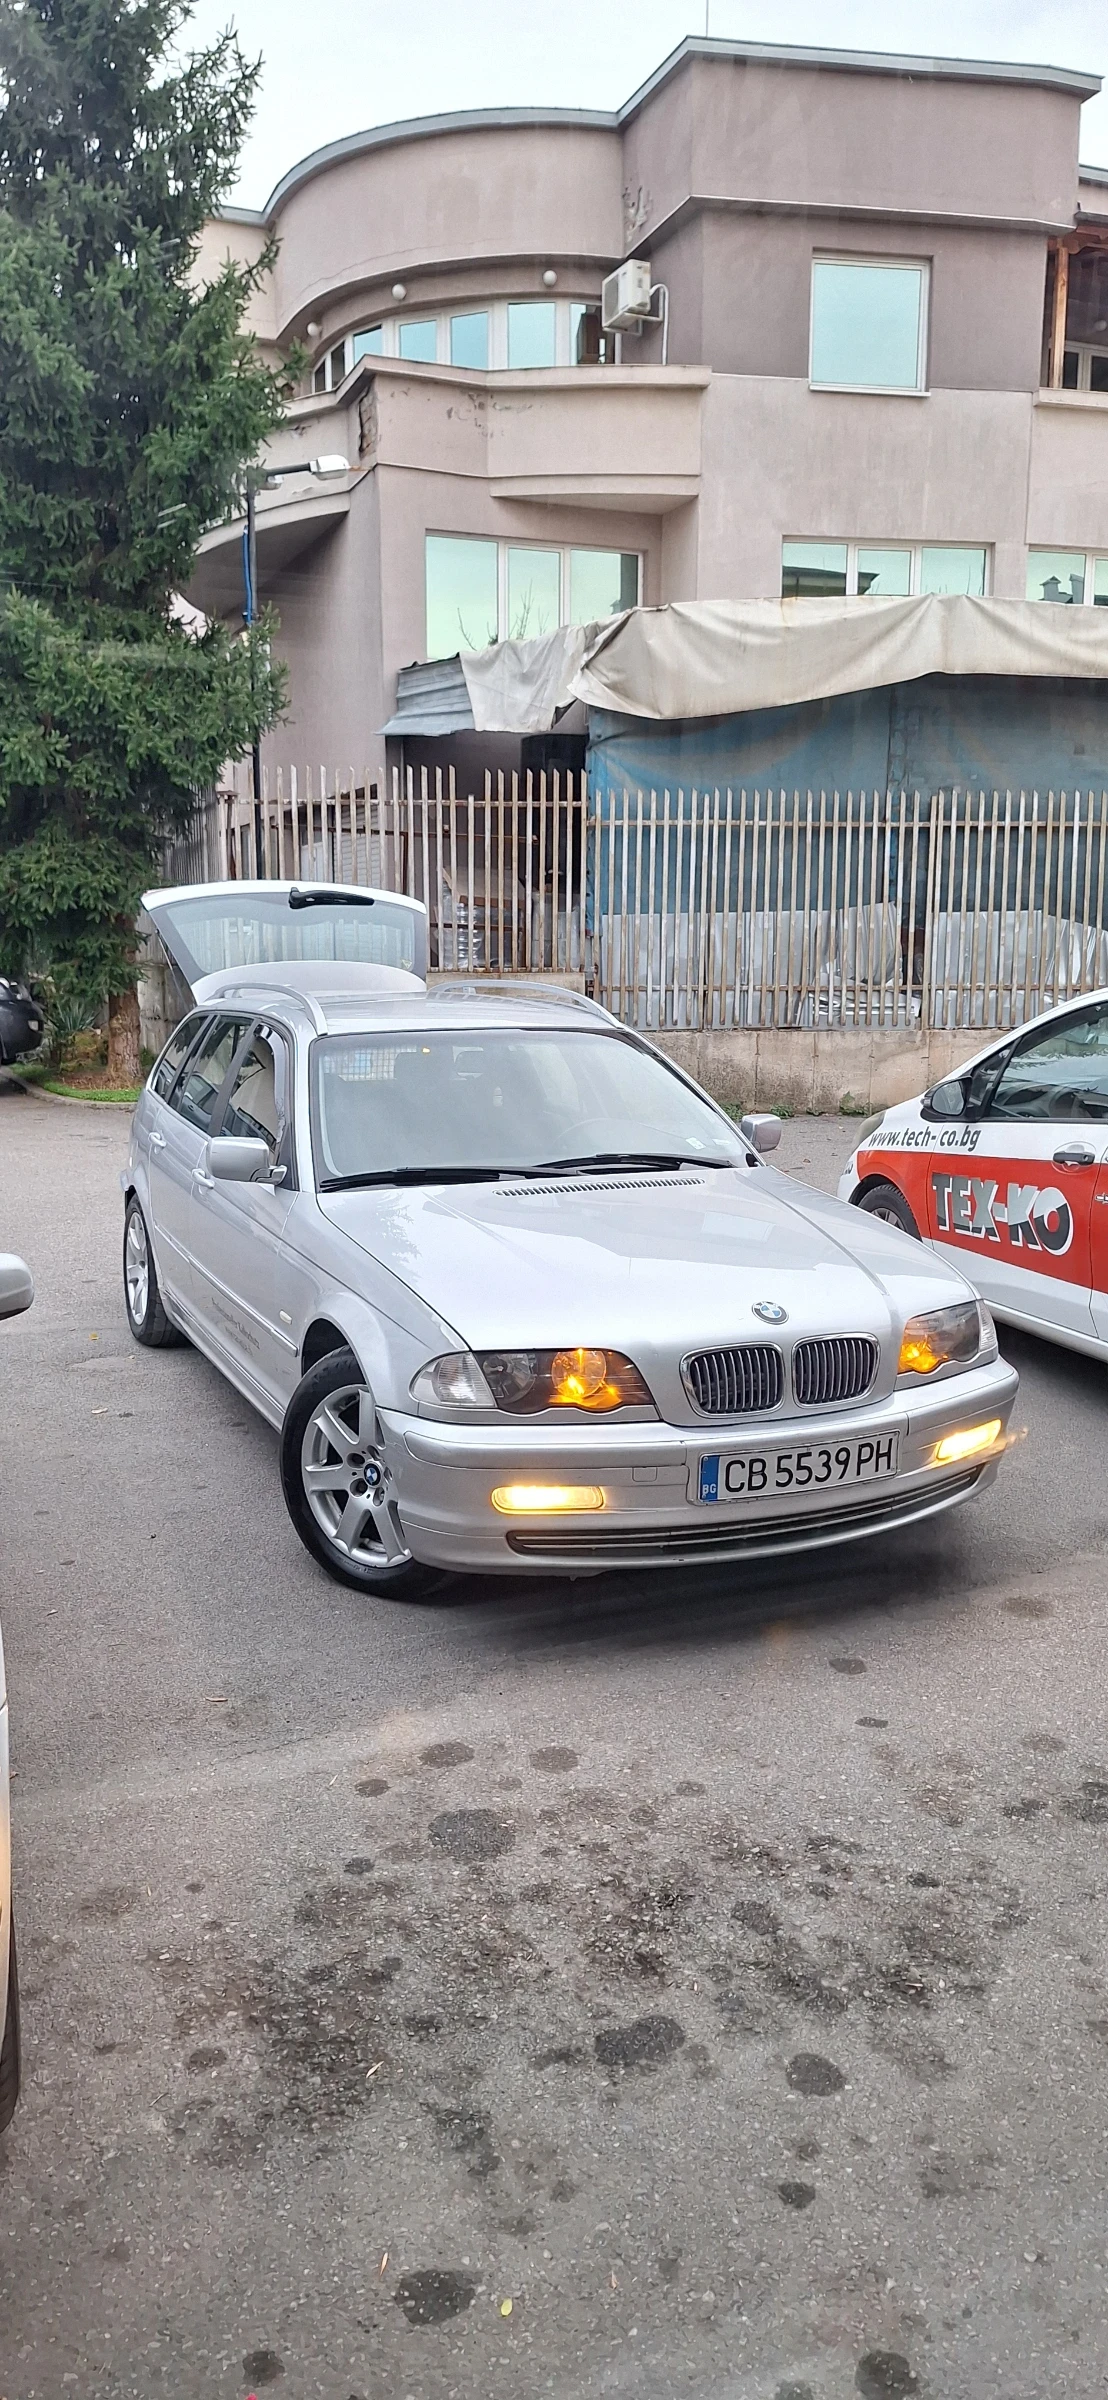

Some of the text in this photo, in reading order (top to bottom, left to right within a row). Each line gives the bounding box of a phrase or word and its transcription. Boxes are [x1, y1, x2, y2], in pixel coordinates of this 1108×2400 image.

[724, 1437, 893, 1493] CB 5539 PH
[702, 1483, 717, 1495] BG
